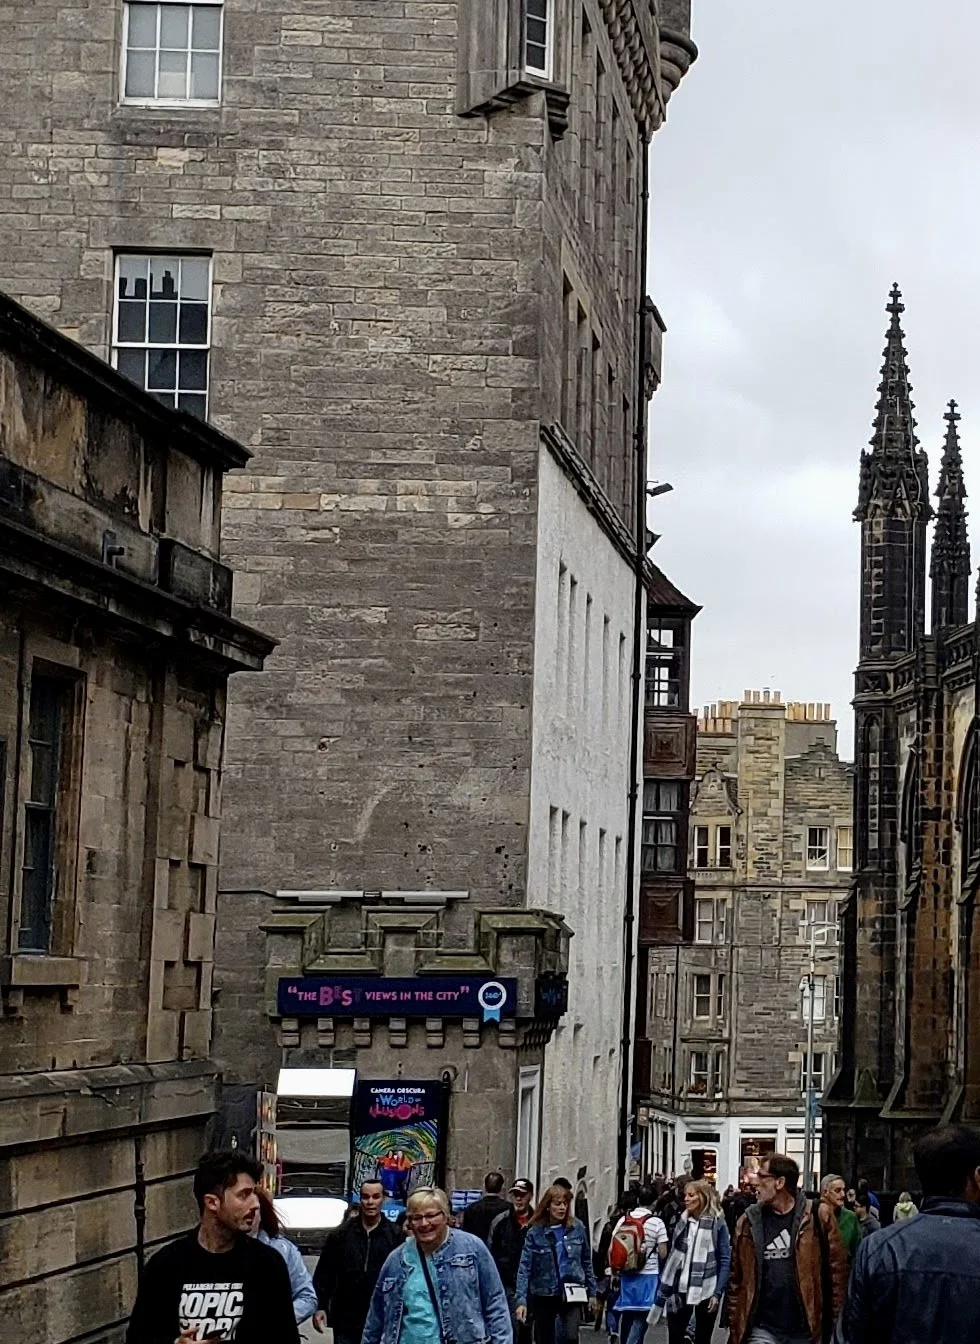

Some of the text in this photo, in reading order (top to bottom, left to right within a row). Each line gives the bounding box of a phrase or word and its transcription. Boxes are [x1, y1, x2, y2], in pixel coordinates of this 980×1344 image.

[365, 991, 398, 1001] VIEWS
[400, 991, 412, 1001] IN
[414, 991, 434, 1001] THE
